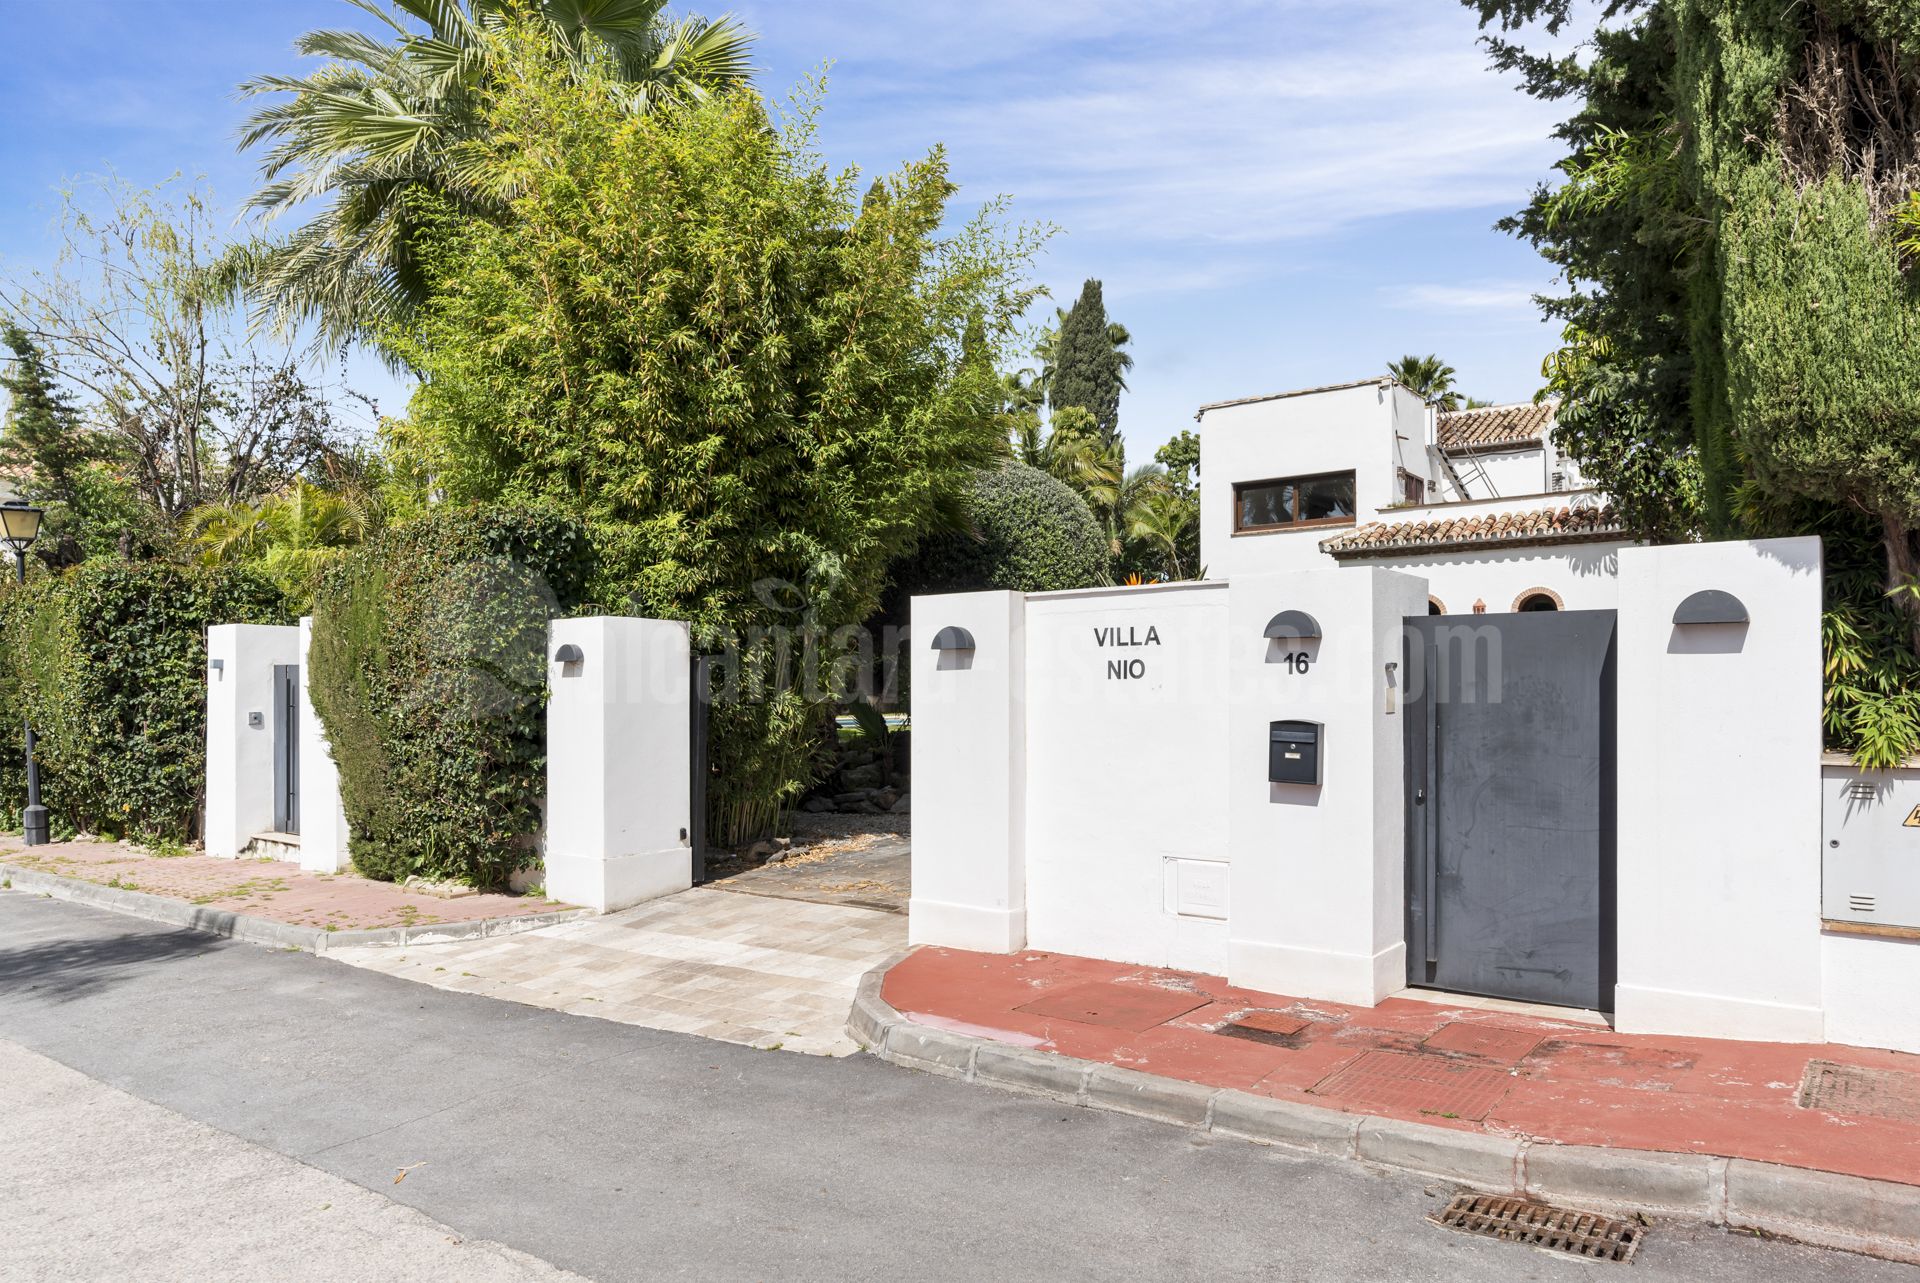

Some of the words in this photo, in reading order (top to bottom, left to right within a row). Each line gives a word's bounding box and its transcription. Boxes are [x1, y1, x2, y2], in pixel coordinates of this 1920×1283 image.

[1093, 626, 1161, 647] VILLA
[1107, 658, 1146, 680] NIO
[1283, 652, 1310, 675] 16
